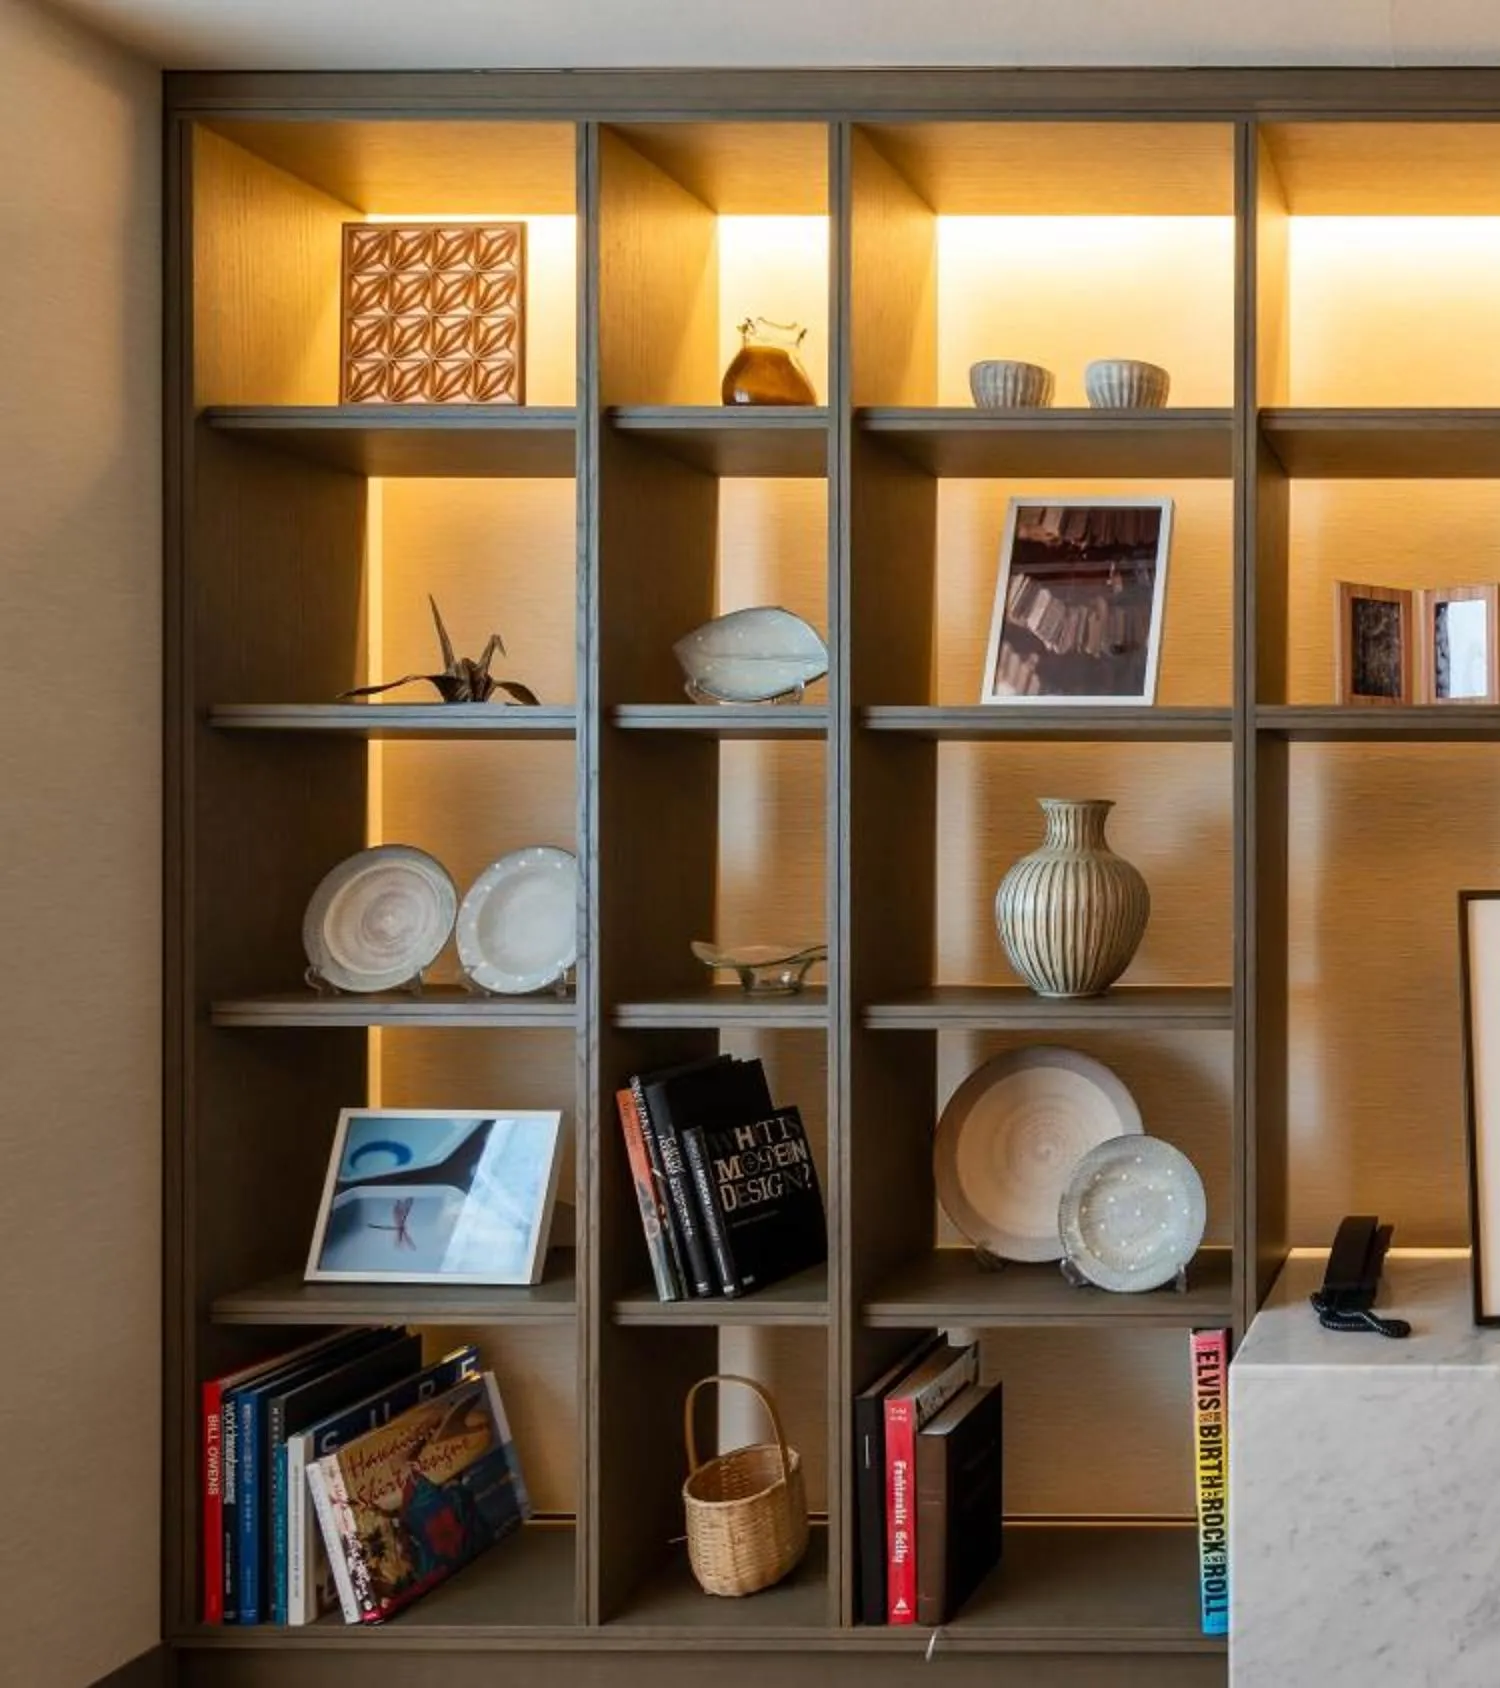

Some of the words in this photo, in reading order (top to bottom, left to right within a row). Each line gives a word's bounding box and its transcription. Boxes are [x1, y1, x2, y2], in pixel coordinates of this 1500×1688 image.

[1197, 1349, 1221, 1411] ELVIS
[207, 1413, 219, 1444] BILL
[1199, 1423, 1223, 1489] BIRTH
[207, 1446, 219, 1496] OWENS
[1201, 1498, 1226, 1555] ROCK
[1203, 1563, 1229, 1617] ROLL
